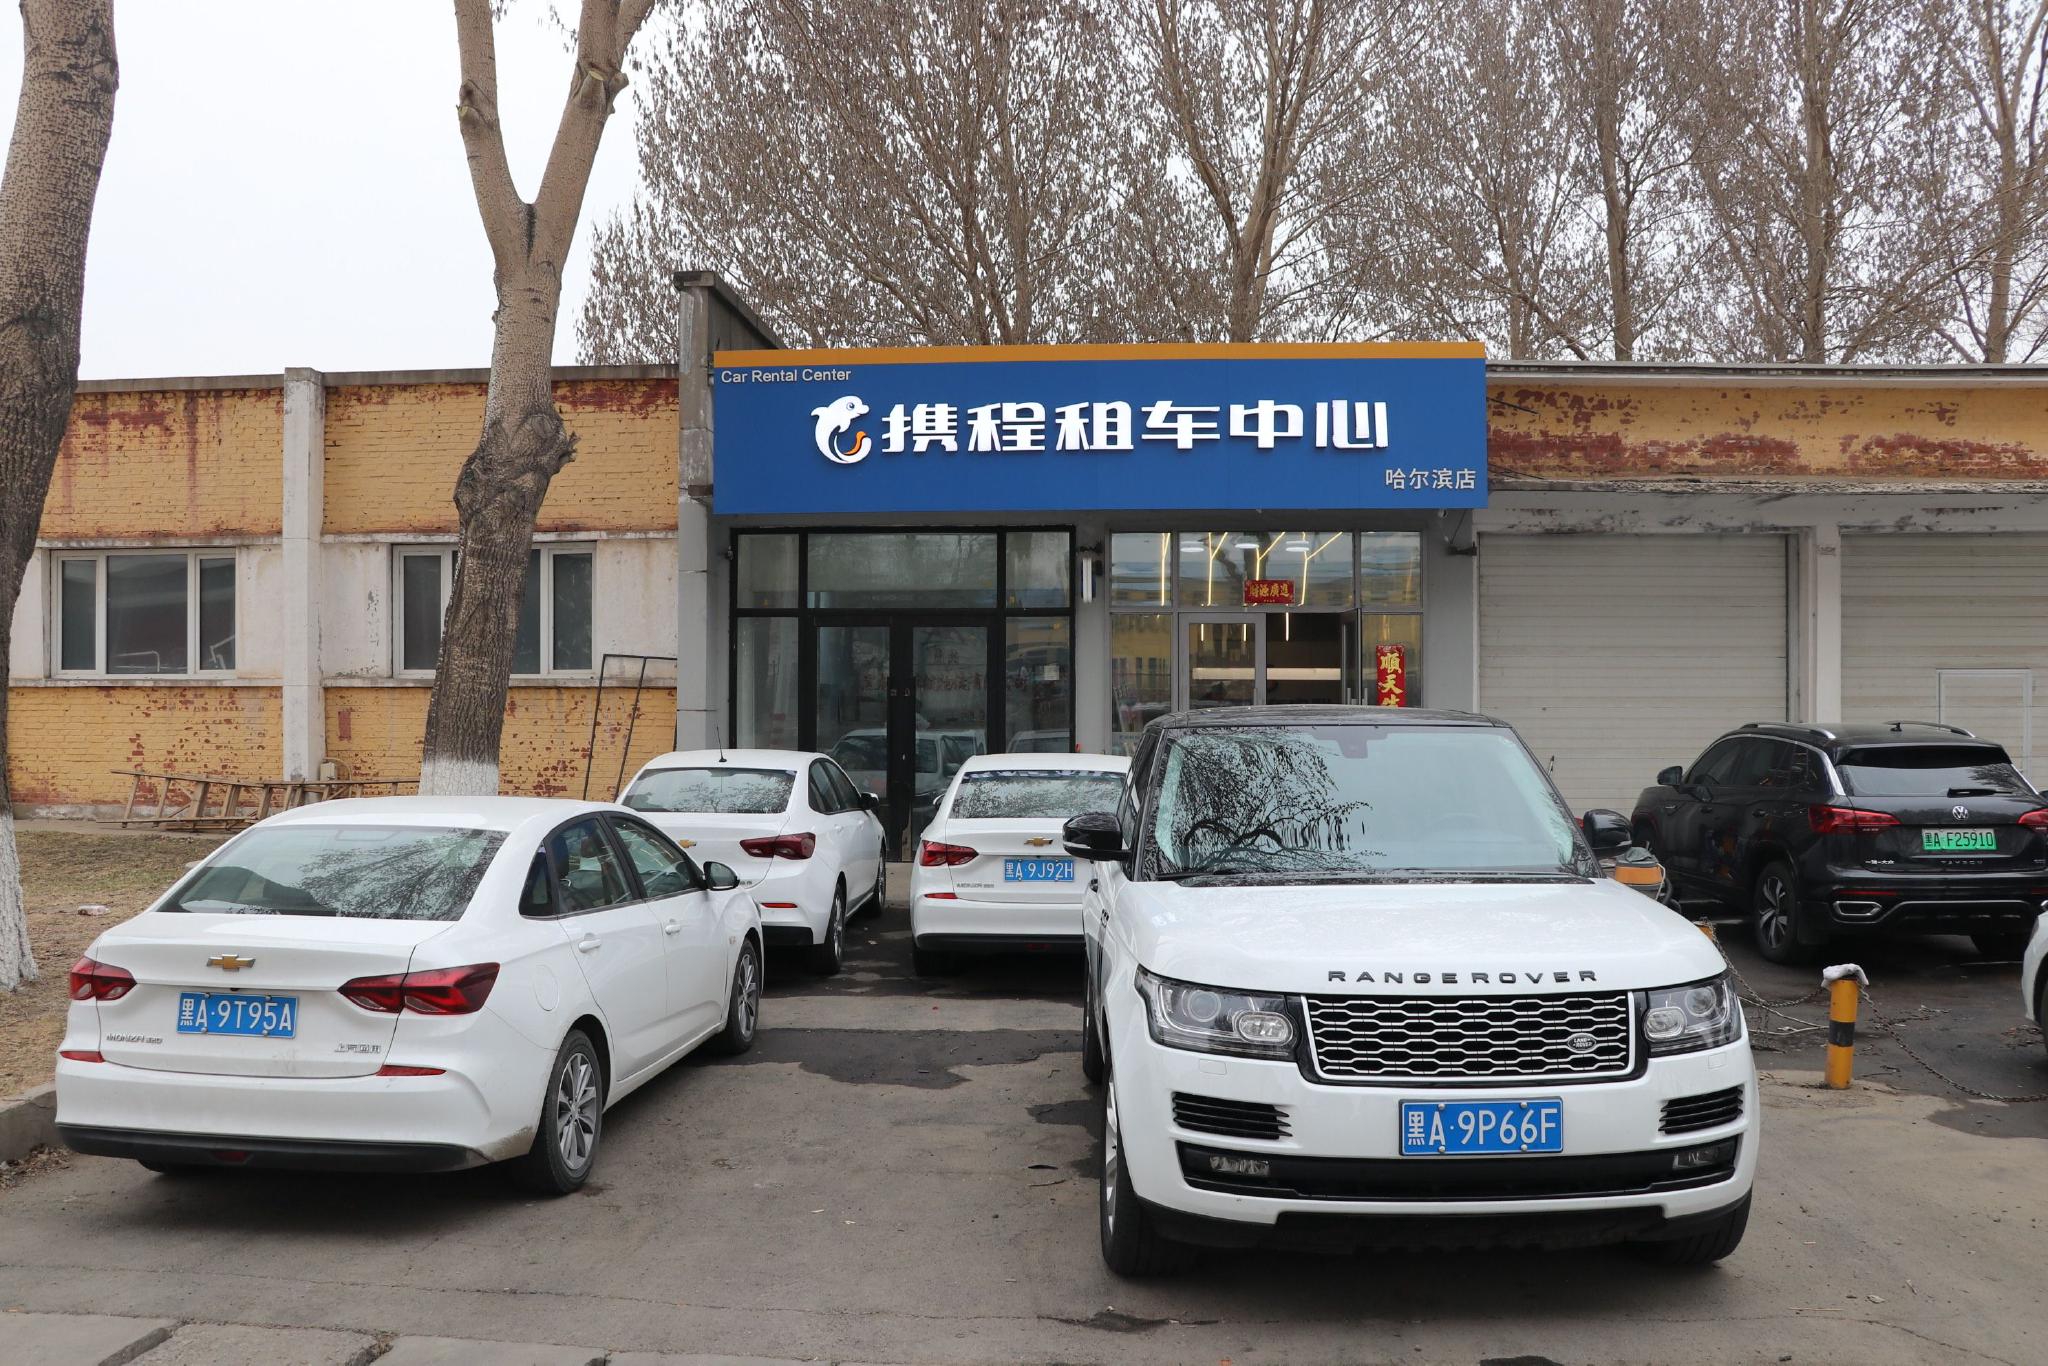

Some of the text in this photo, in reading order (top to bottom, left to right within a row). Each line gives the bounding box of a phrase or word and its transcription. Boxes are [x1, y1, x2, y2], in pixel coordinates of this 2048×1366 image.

[721, 368, 852, 383] Car Rental Center
[881, 399, 1389, 453] 携程租车中心
[1385, 467, 1476, 490] 哈尔滨店
